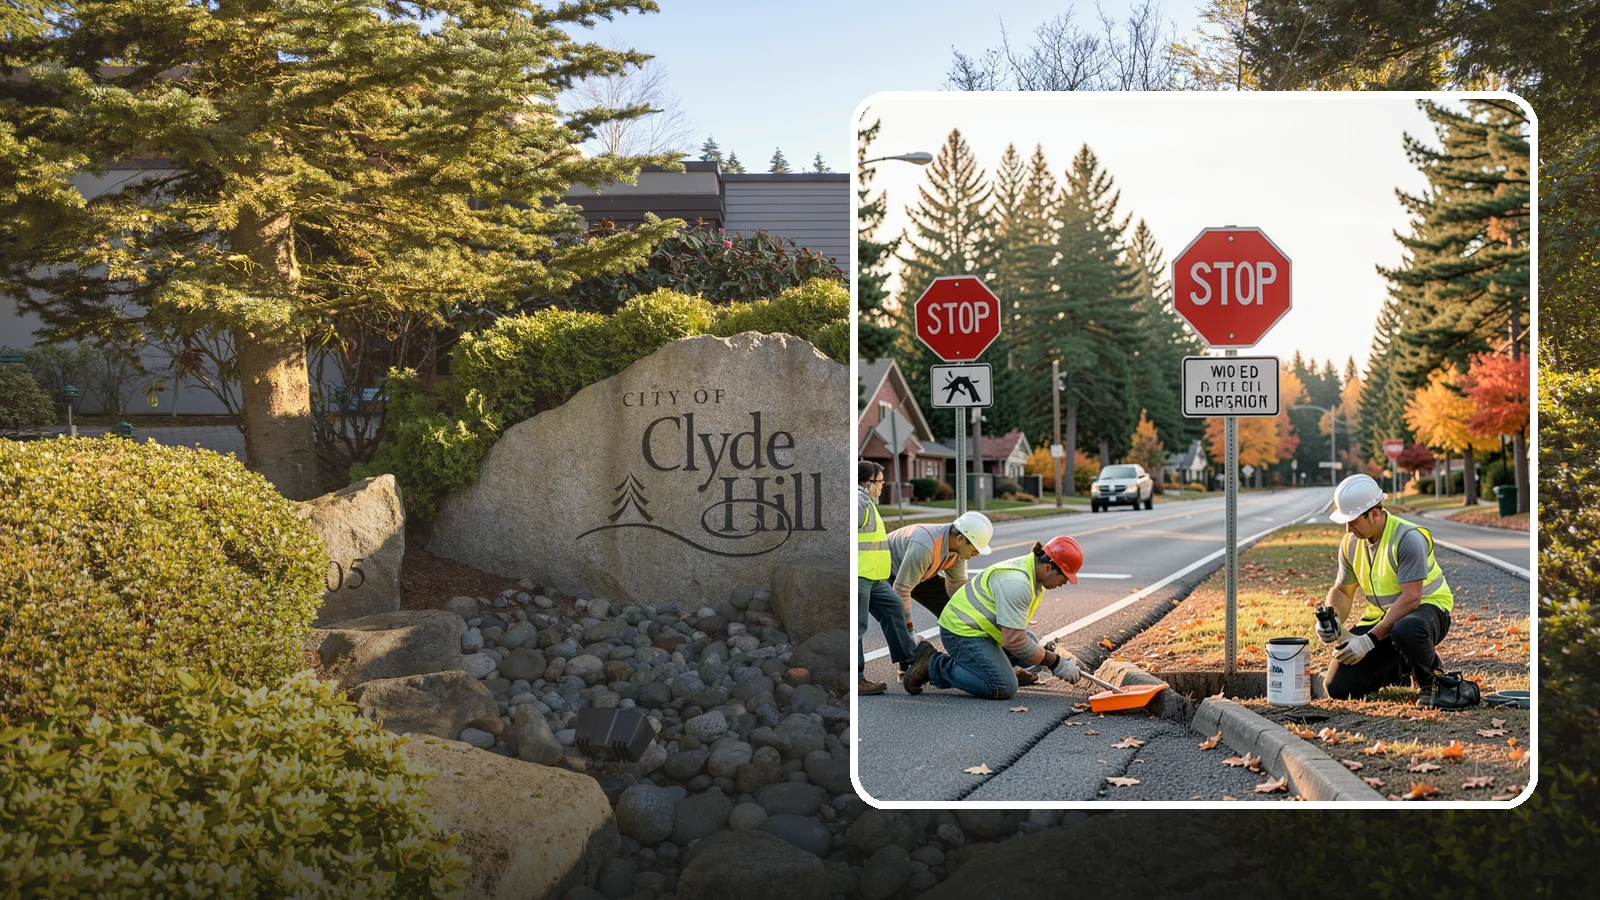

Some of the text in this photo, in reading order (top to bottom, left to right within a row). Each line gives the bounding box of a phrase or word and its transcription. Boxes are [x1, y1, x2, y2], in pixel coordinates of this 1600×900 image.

[1189, 260, 1277, 306] STOP
[927, 301, 990, 335] STOP
[622, 388, 726, 407] CITY OF
[641, 411, 795, 493] Clyde
[718, 472, 828, 532] Hill
